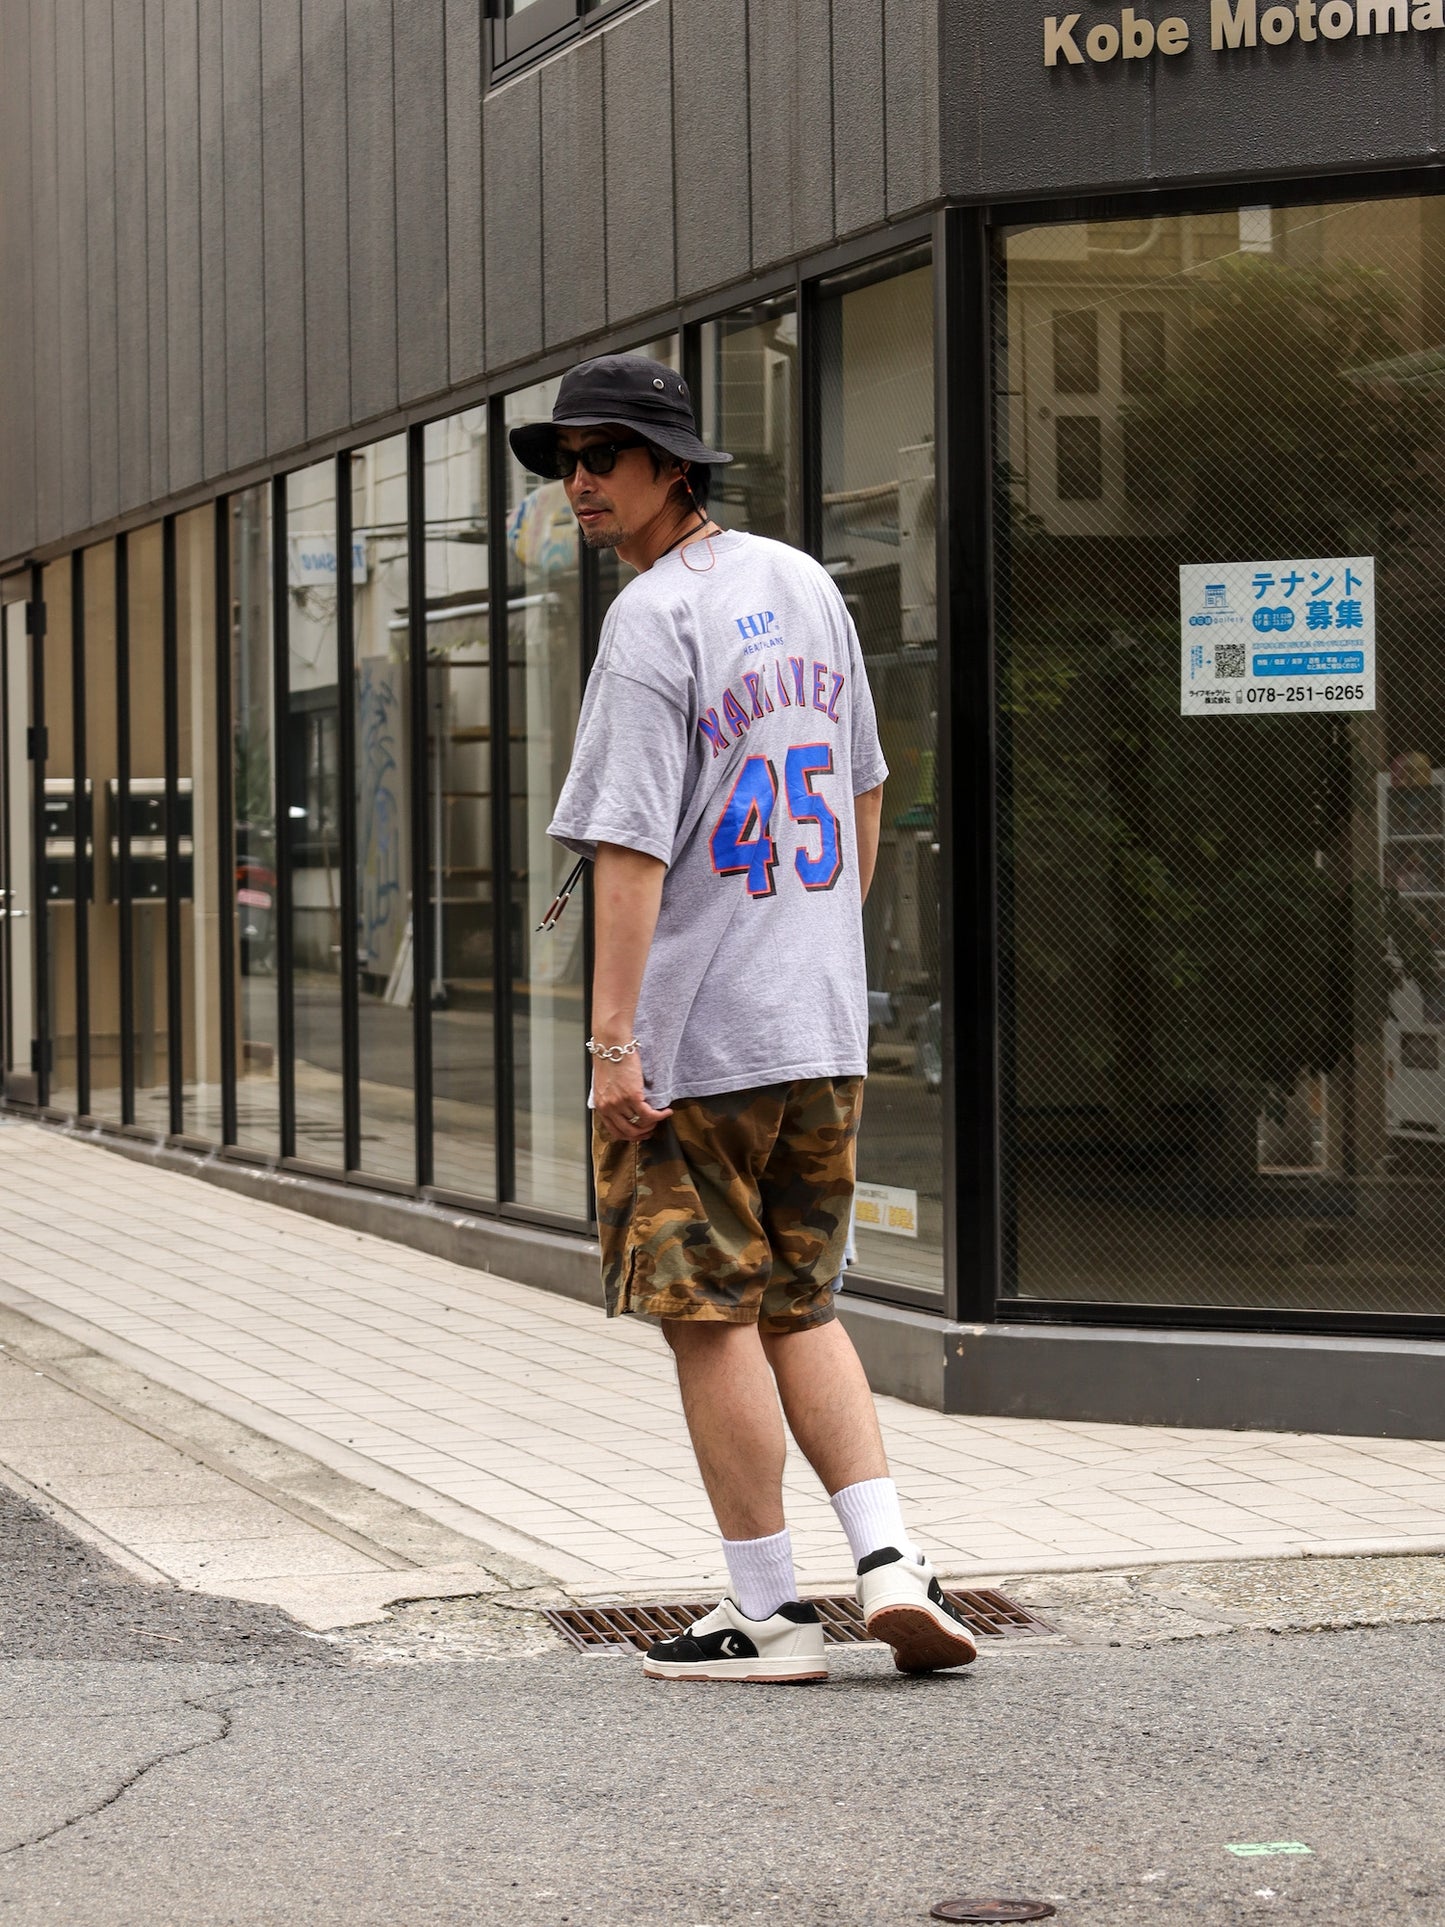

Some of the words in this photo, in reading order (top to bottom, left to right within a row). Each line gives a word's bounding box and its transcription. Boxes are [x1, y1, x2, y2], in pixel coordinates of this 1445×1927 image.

[1043, 7, 1190, 66] Kobe
[1210, 0, 1445, 51] Motoma
[1251, 567, 1363, 599] テナント
[1305, 600, 1364, 630] 募集
[1246, 685, 1364, 703] 078-251-6265
[708, 742, 844, 899] 45
